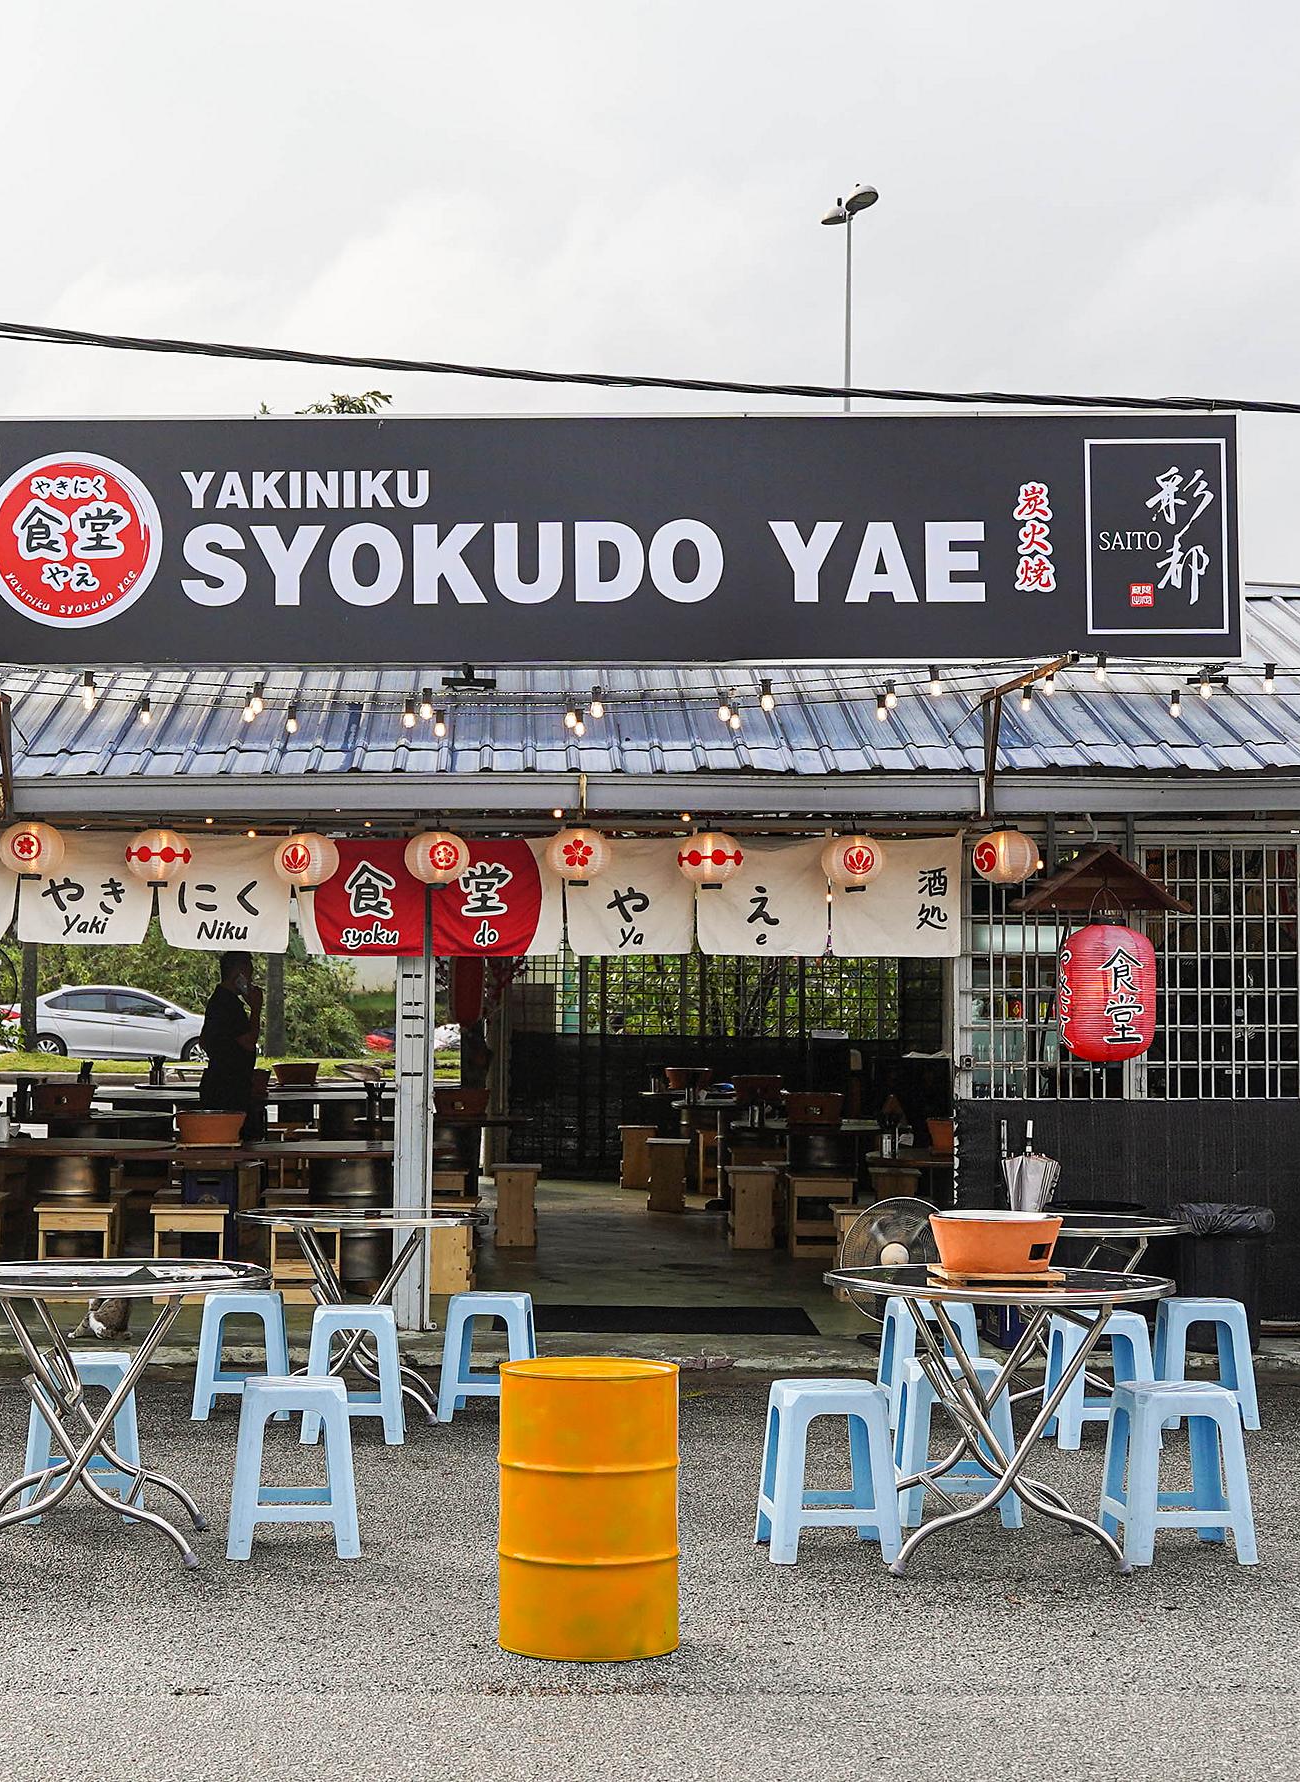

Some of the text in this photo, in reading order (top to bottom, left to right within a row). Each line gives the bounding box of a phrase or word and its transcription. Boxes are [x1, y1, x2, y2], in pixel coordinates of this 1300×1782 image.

[33, 477, 105, 497] やきにく
[180, 470, 430, 509] YAKINIKU
[17, 503, 127, 556] 食堂
[1015, 484, 1054, 590] 炭火焼
[1098, 531, 1162, 551] SAITO
[44, 565, 98, 589] やえ
[180, 519, 986, 607] SYOKUDO YAE
[5, 572, 51, 611] yakiniku
[59, 592, 114, 615] syokudo
[41, 877, 260, 917] やき にく
[346, 861, 512, 917] 食 堂
[606, 885, 780, 926] や え
[916, 866, 948, 930] 酒処
[62, 914, 249, 940] Yaki Niku
[341, 920, 499, 948] syoku do
[755, 933, 768, 946] e
[1098, 946, 1144, 1045] 食堂
